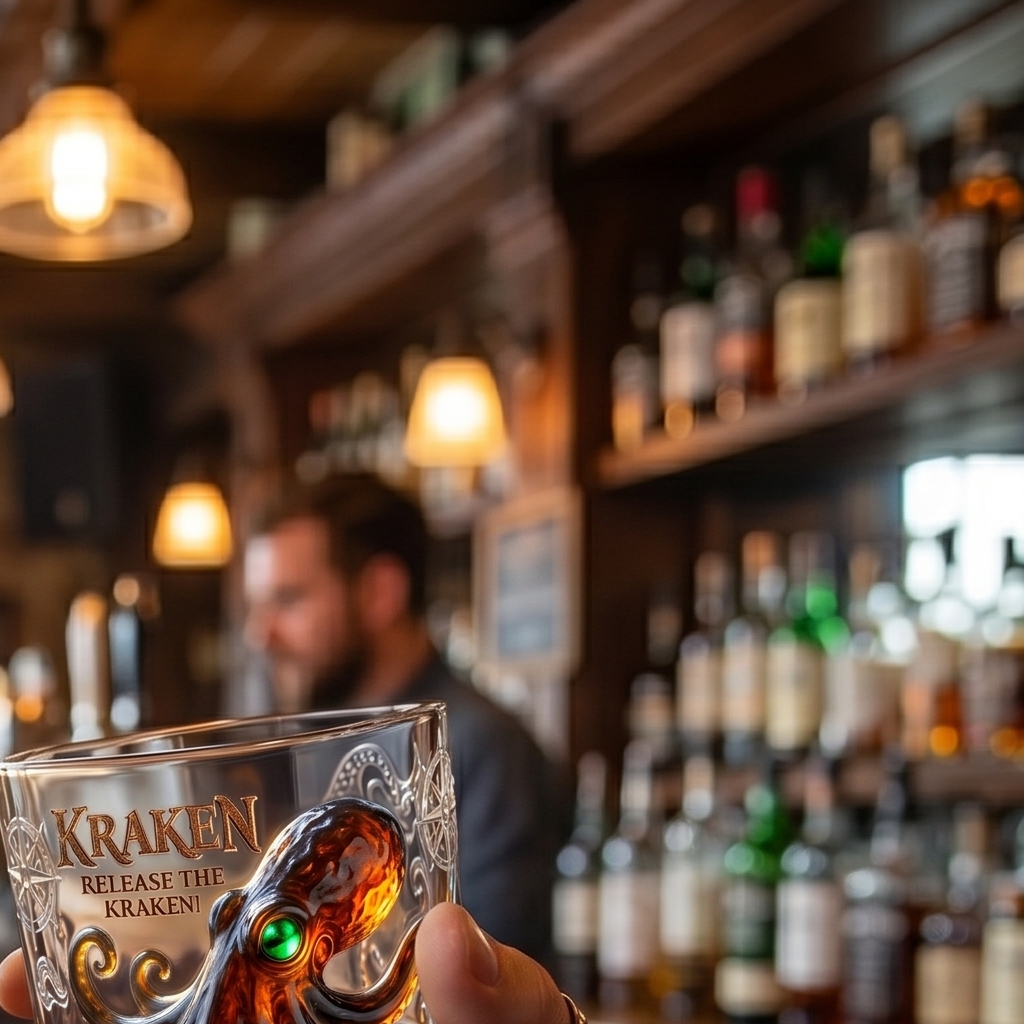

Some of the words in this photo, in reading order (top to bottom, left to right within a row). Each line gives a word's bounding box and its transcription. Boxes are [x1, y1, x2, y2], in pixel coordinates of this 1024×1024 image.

[51, 795, 261, 868] KRAKEN
[81, 872, 174, 895] RELEASE
[178, 867, 225, 888] THE
